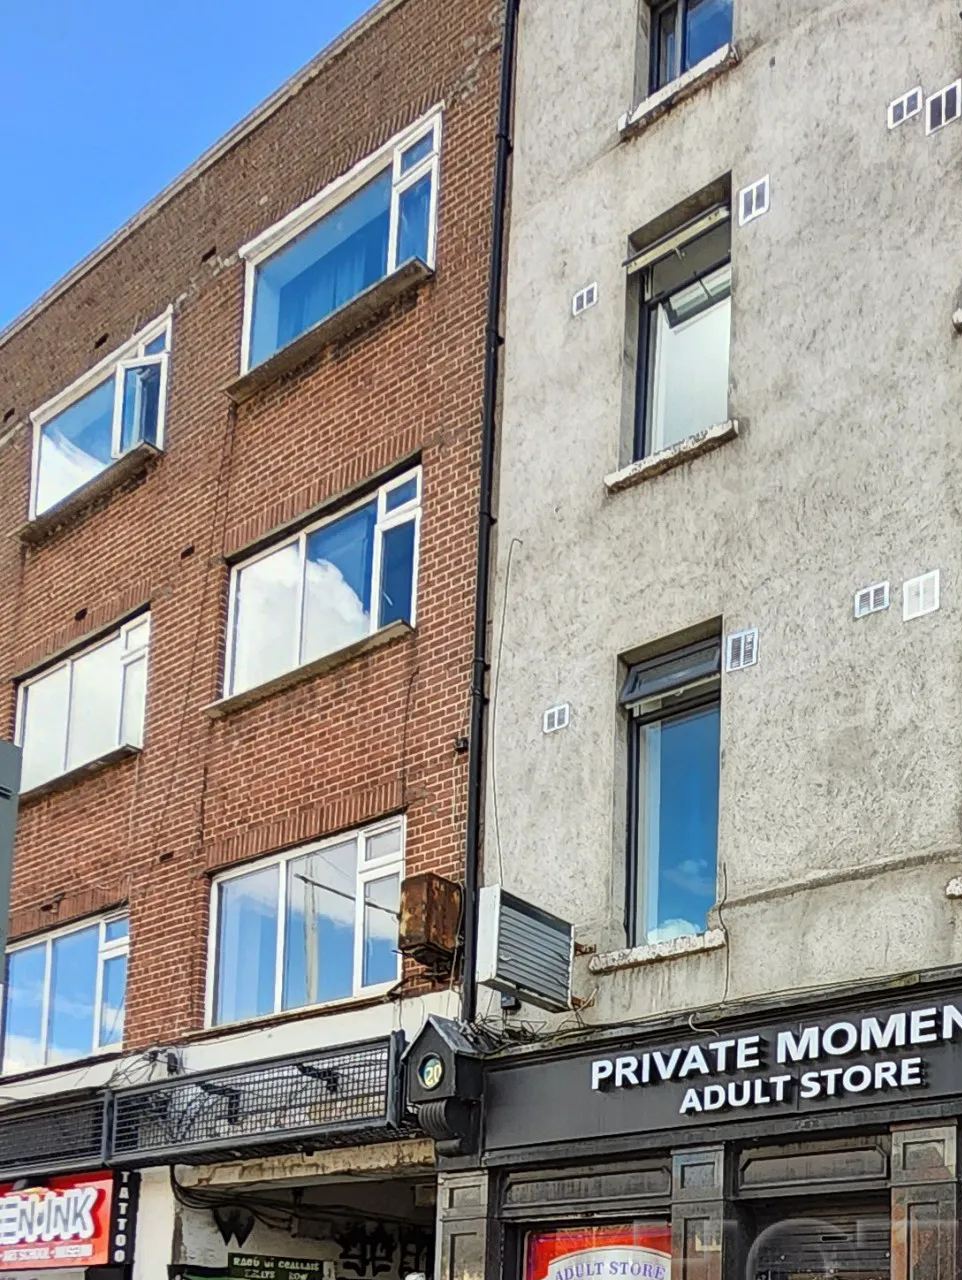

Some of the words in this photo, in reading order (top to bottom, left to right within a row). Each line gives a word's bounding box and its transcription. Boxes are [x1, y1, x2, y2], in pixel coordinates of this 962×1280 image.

[425, 1065, 443, 1086] 20
[591, 1035, 761, 1091] PRIVATE
[679, 1075, 792, 1114] ADULT
[801, 1057, 923, 1099] STORE
[114, 1171, 131, 1263] TATTOO
[609, 1260, 666, 1280] STORE
